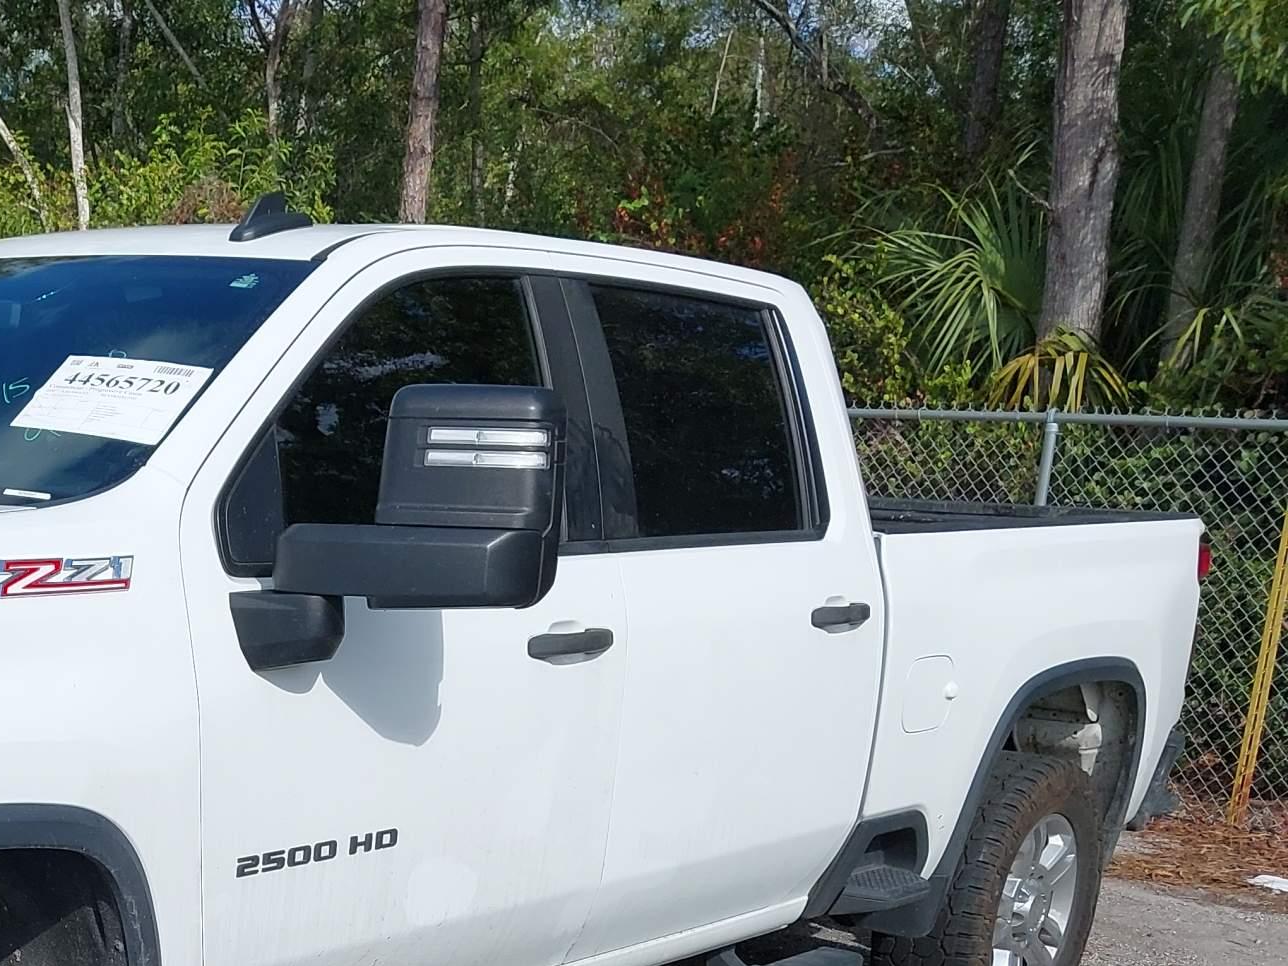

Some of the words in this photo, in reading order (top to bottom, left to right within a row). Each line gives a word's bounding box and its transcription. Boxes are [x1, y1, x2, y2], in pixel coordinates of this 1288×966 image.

[64, 371, 181, 395] 44565720
[235, 839, 338, 878] 2500
[348, 827, 398, 856] HD
